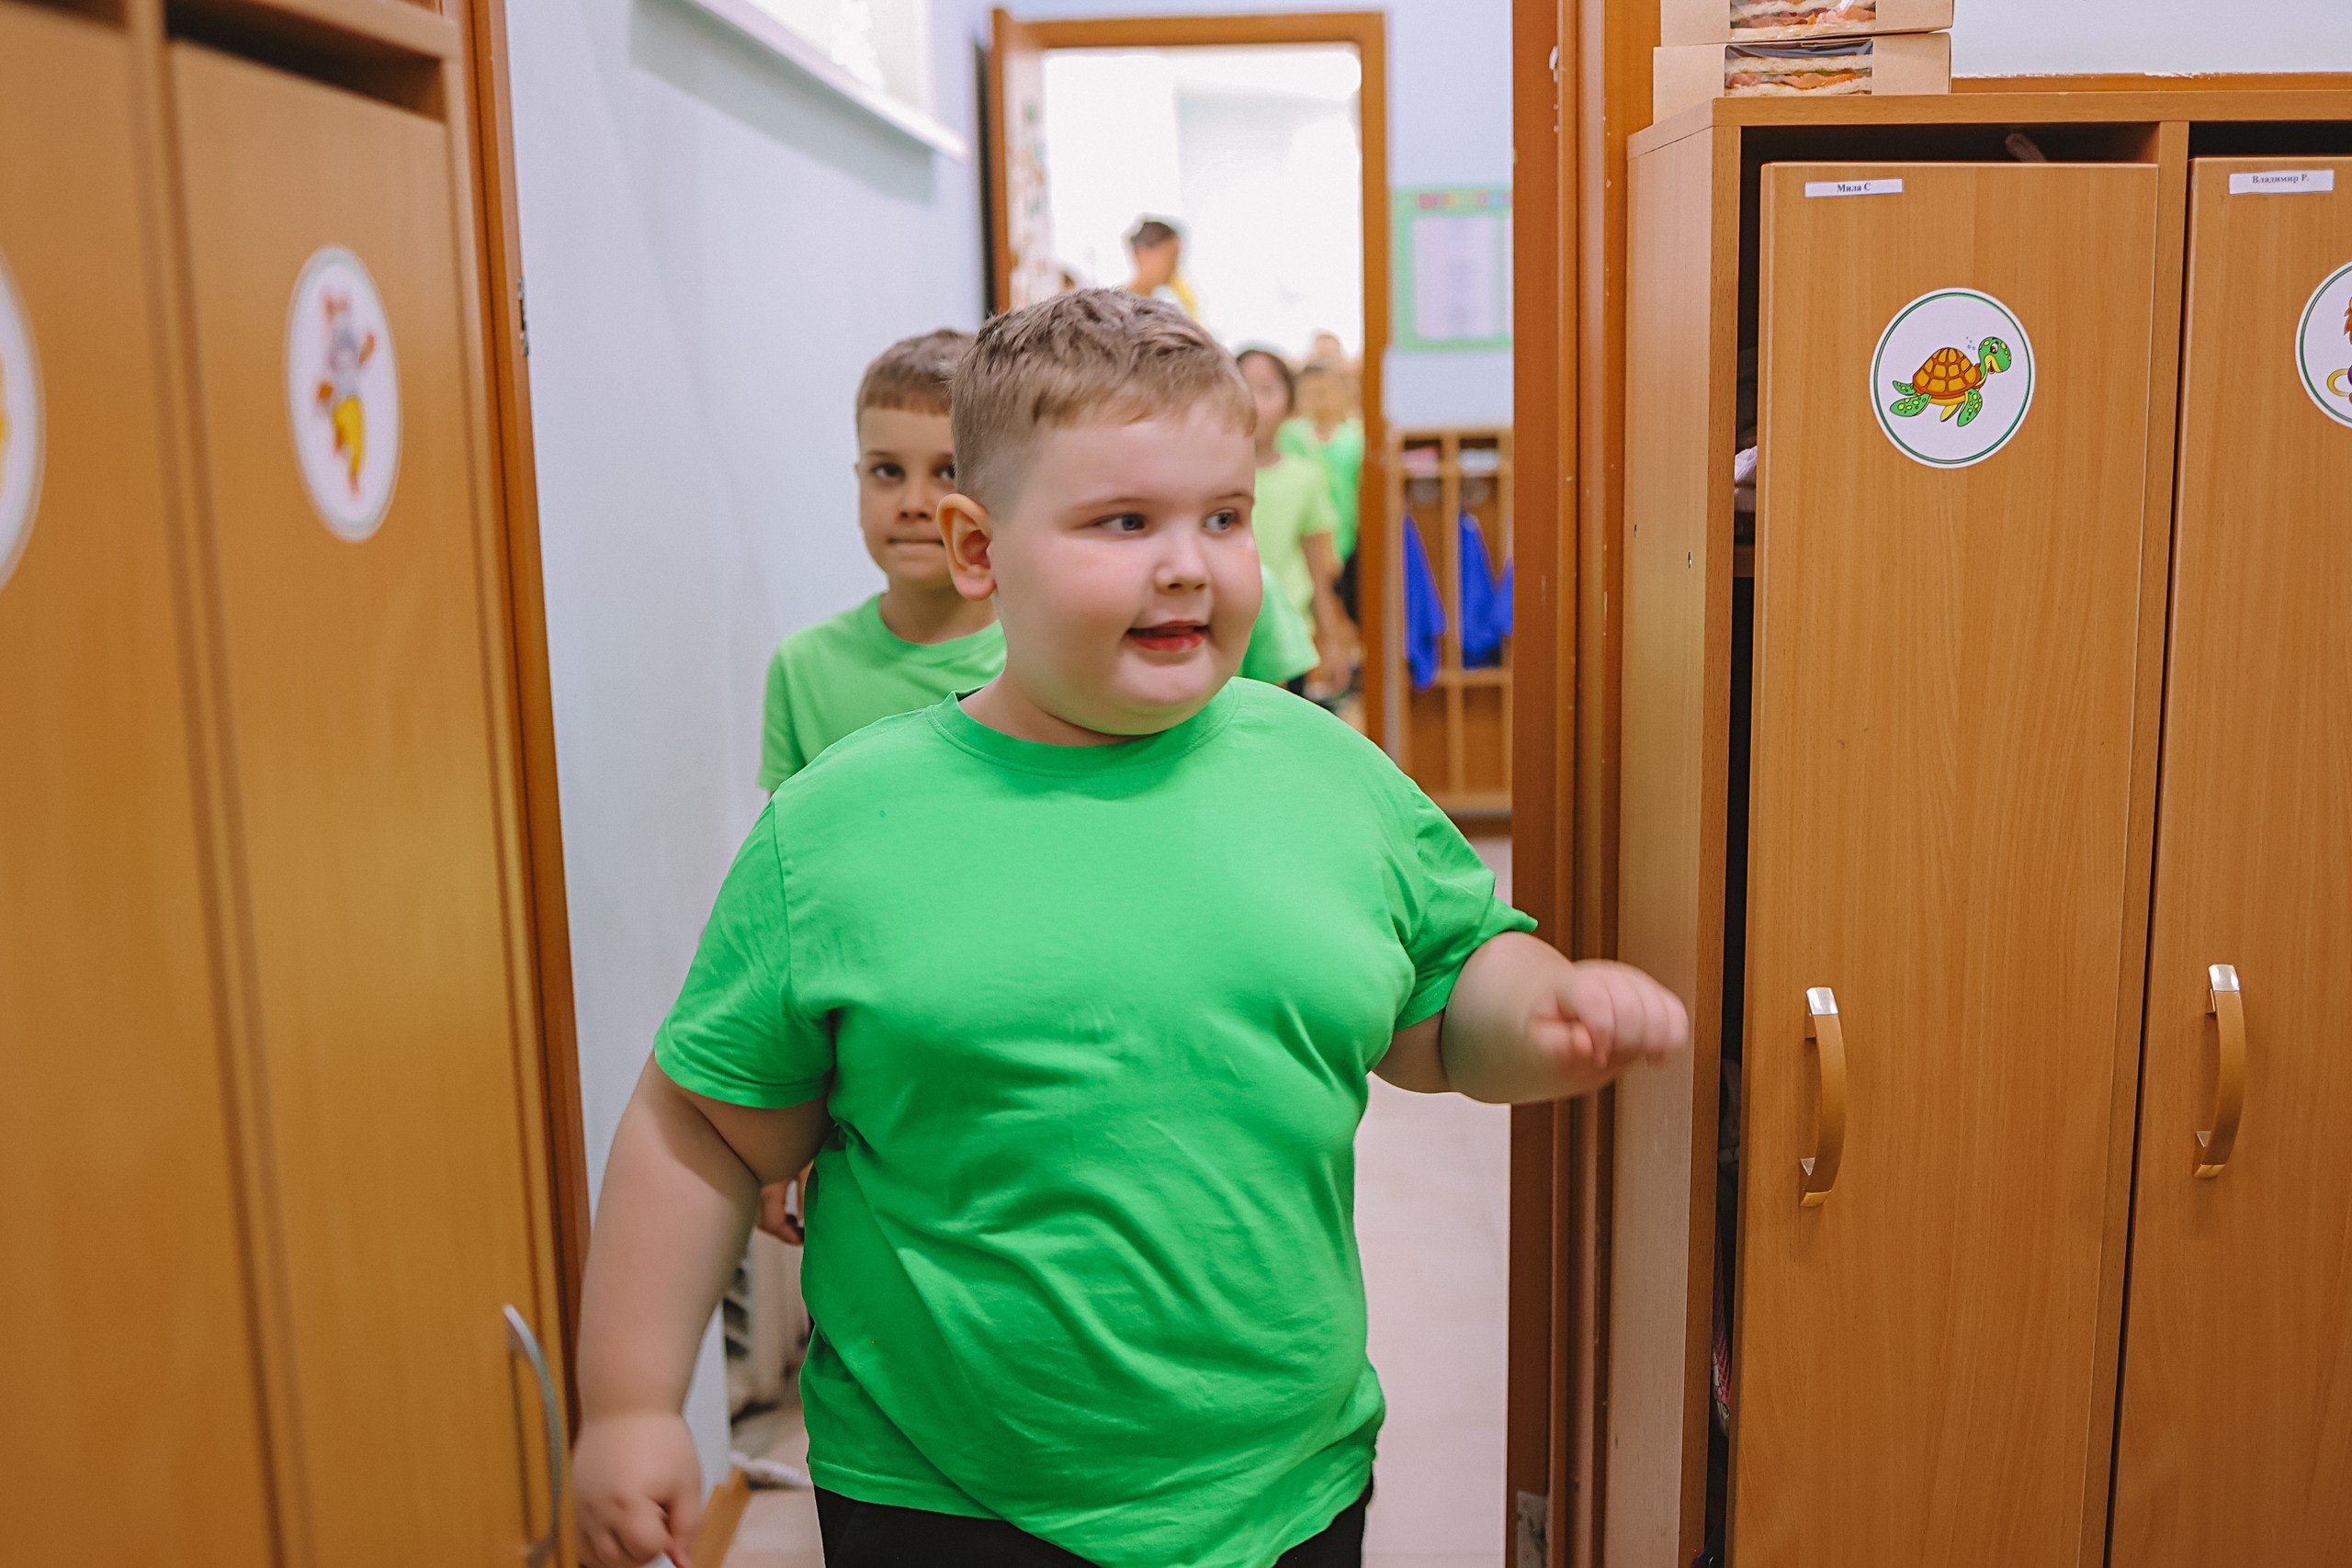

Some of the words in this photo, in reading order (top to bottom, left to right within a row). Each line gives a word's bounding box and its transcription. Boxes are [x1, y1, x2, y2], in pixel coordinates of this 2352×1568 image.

[2252, 175, 2299, 184] Владимир
[2301, 174, 2310, 182] Р.
[1837, 184, 1861, 193] Мила
[1864, 183, 1871, 191] С
